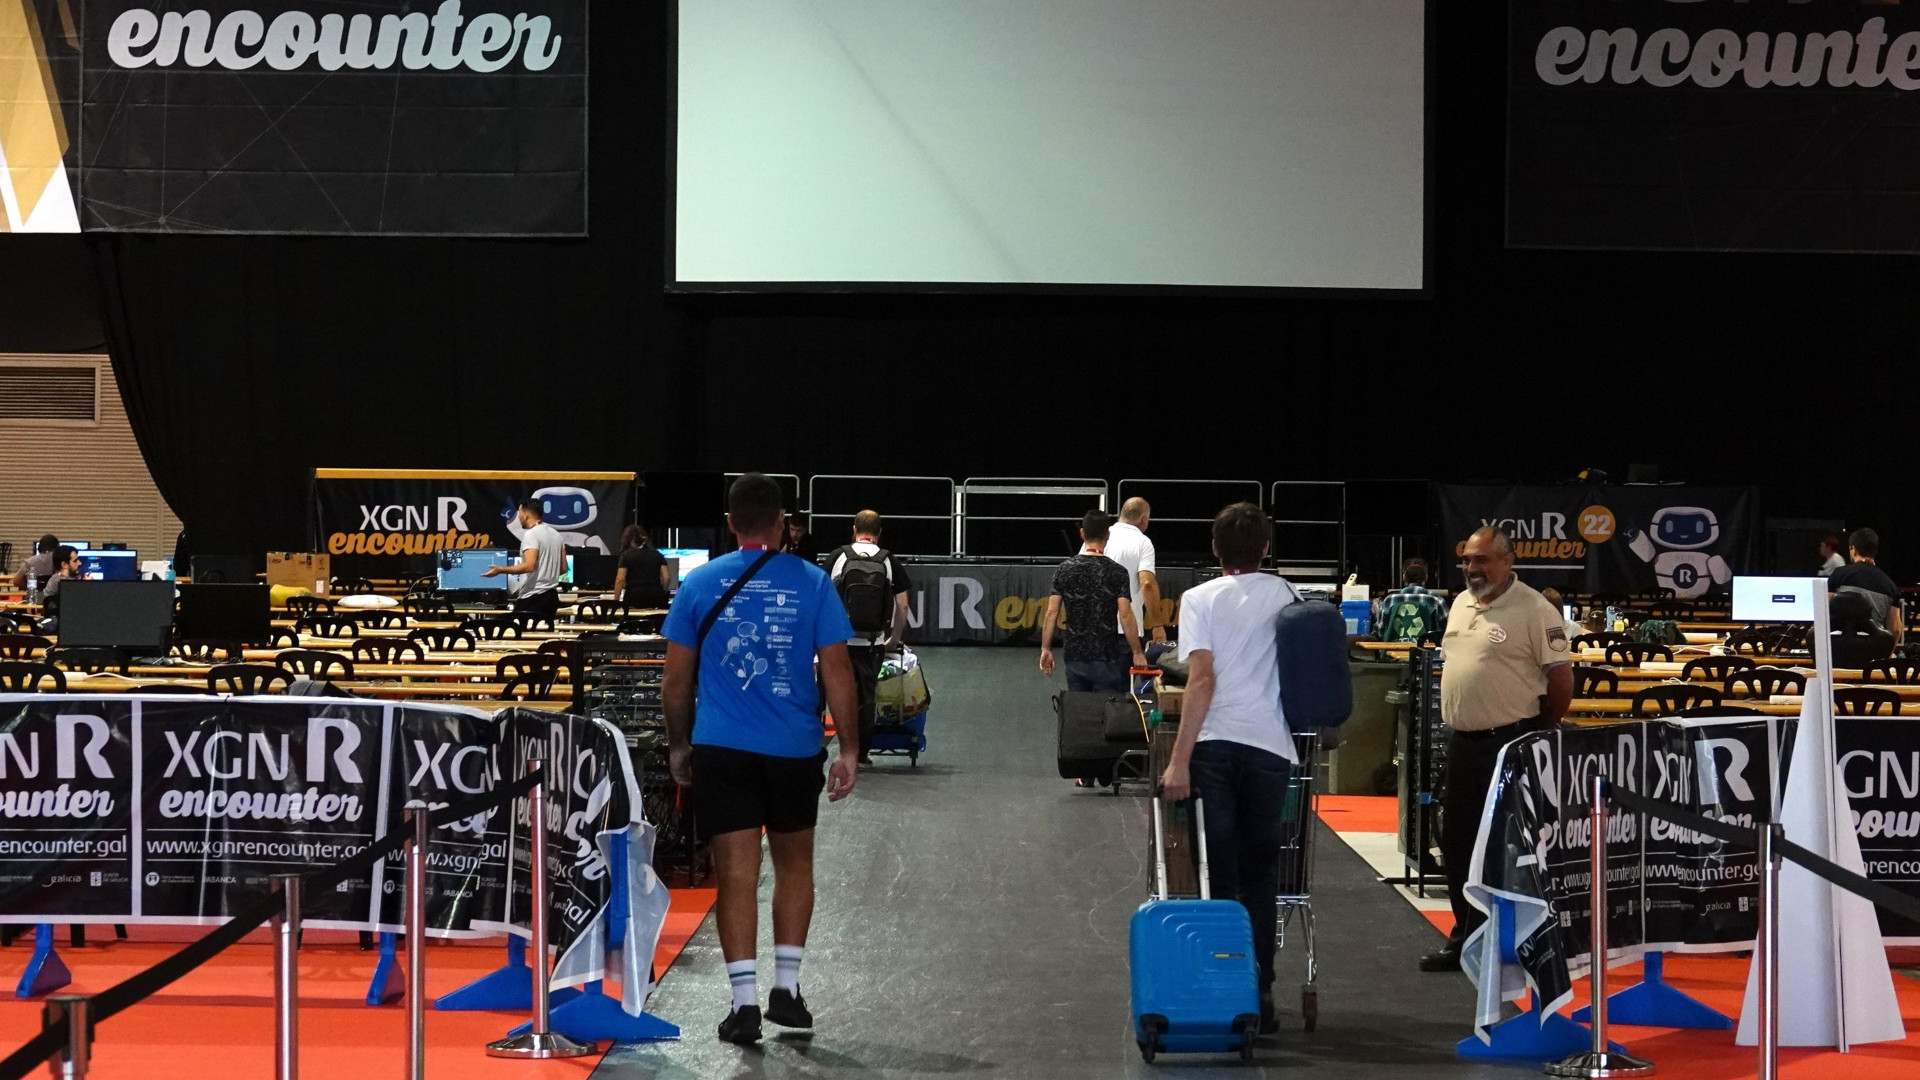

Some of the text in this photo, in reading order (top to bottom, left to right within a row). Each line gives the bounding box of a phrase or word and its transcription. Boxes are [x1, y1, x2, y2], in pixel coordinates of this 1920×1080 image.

[107, 0, 562, 73] encounter
[359, 496, 469, 532] XGN R
[1542, 512, 1567, 540] R
[1583, 514, 1611, 535] 22
[328, 528, 491, 555] encounter
[1679, 569, 1693, 583] R
[939, 576, 986, 630] R
[56, 714, 115, 779] R
[163, 717, 364, 784] XGN R
[1694, 737, 1755, 806] R
[1837, 749, 1920, 799] GN
[0, 783, 115, 819] unter
[159, 786, 364, 823] encounter
